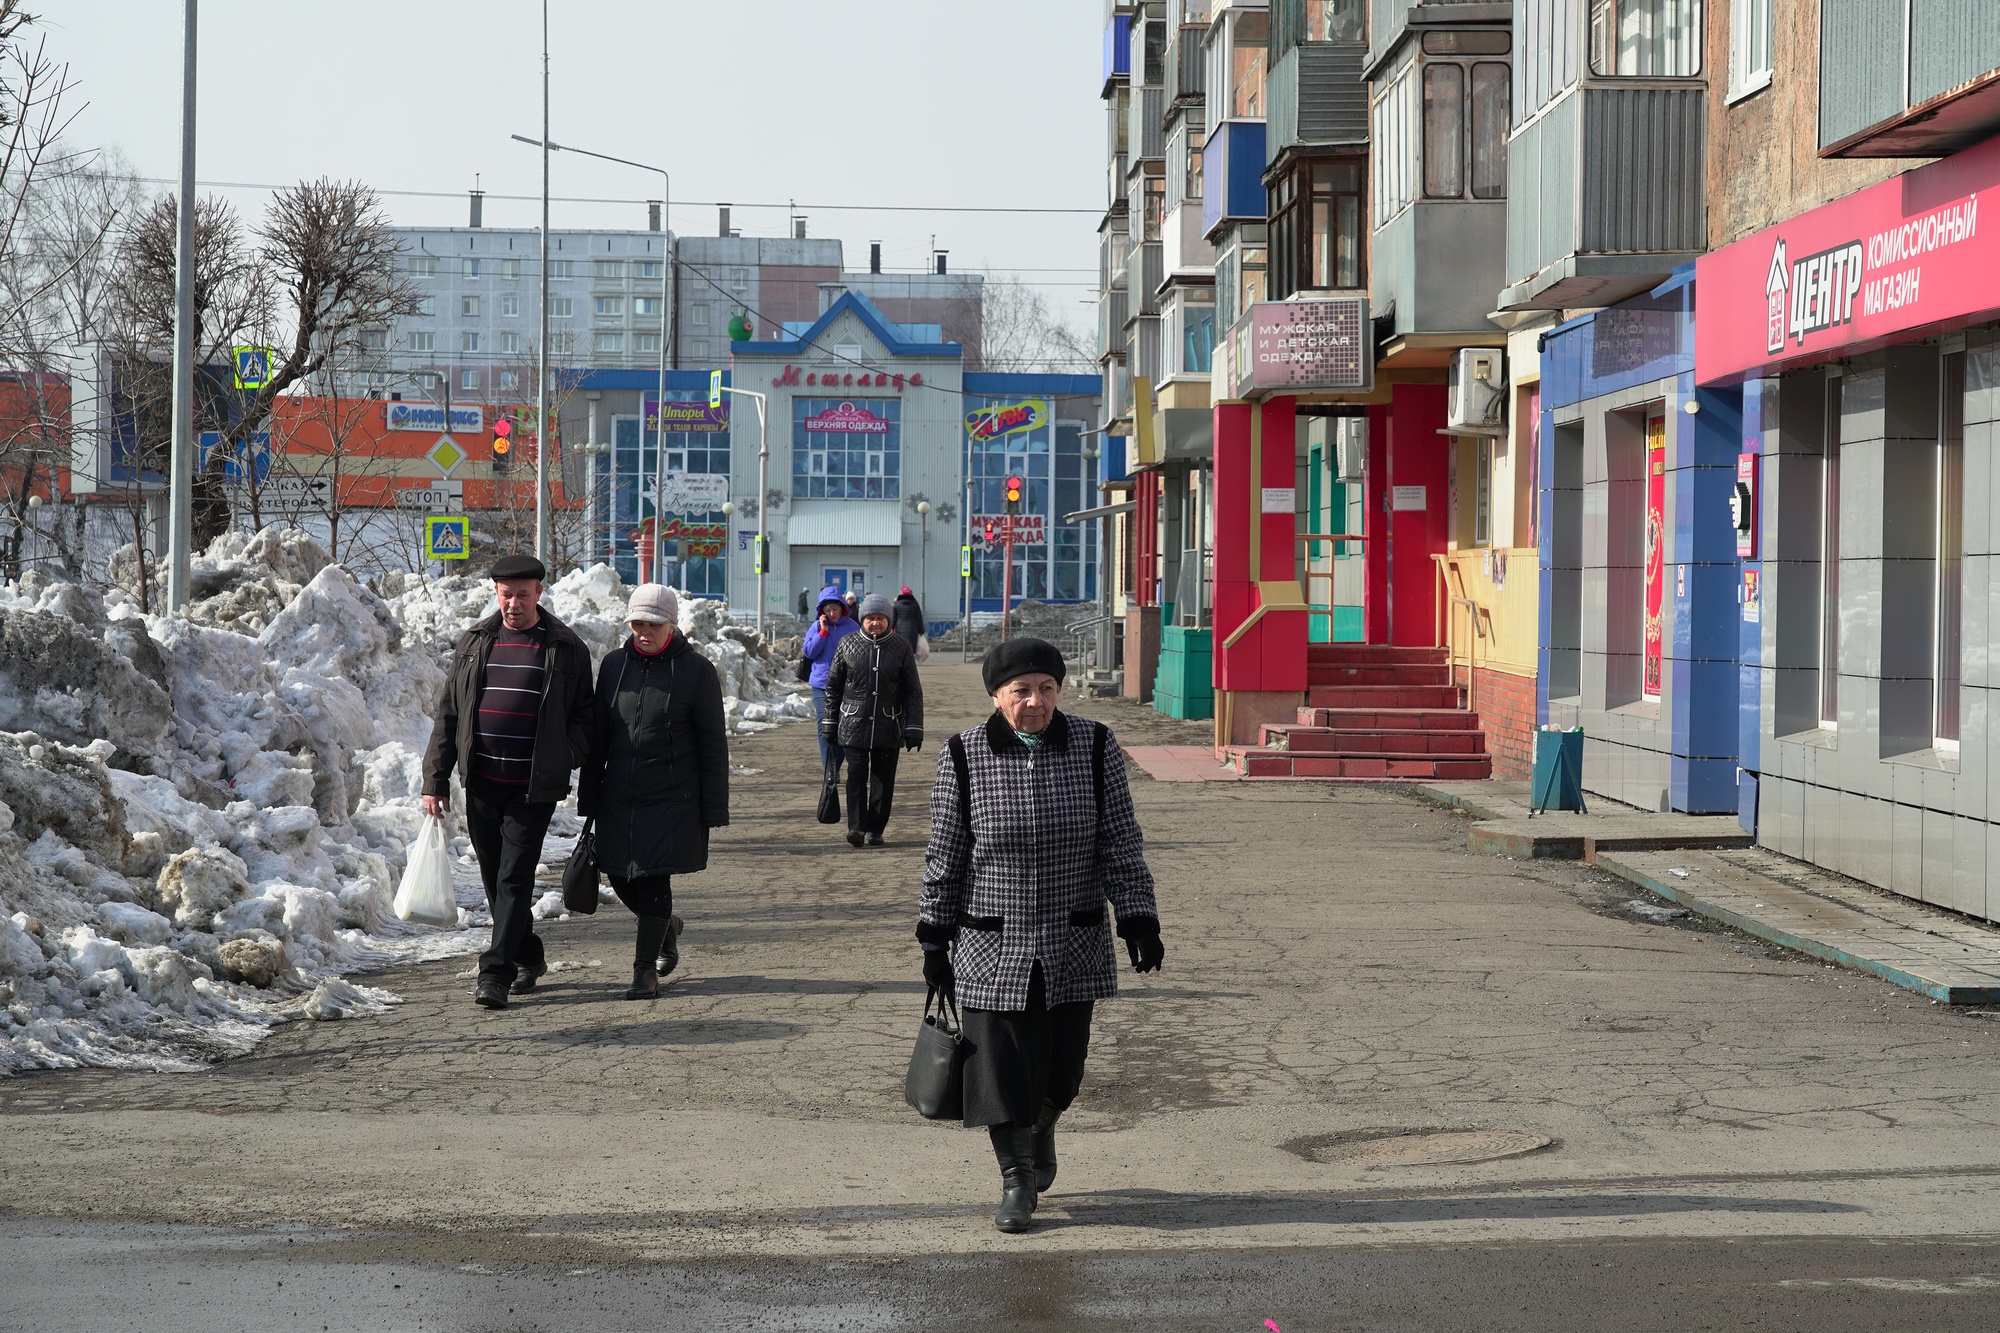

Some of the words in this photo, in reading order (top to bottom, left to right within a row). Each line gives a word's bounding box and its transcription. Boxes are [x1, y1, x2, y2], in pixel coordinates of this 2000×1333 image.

[1866, 192, 1978, 271] КОМИССИОННЫЙ
[1788, 239, 1864, 347] ЦЕНТР
[1863, 266, 1921, 317] МАГАЗИН
[1259, 323, 1336, 335] МУЖСКАЯ
[1259, 339, 1269, 349] И
[1277, 336, 1349, 349] ДЕТСКАЯ
[1259, 352, 1324, 363] ОДЕЖДА
[772, 364, 924, 392] Метелица
[412, 408, 479, 426] НОВЭКС
[807, 420, 846, 430] ВЕРХНЯЯ
[849, 421, 887, 431] ОДЕЖДА
[405, 491, 442, 503] СТОП
